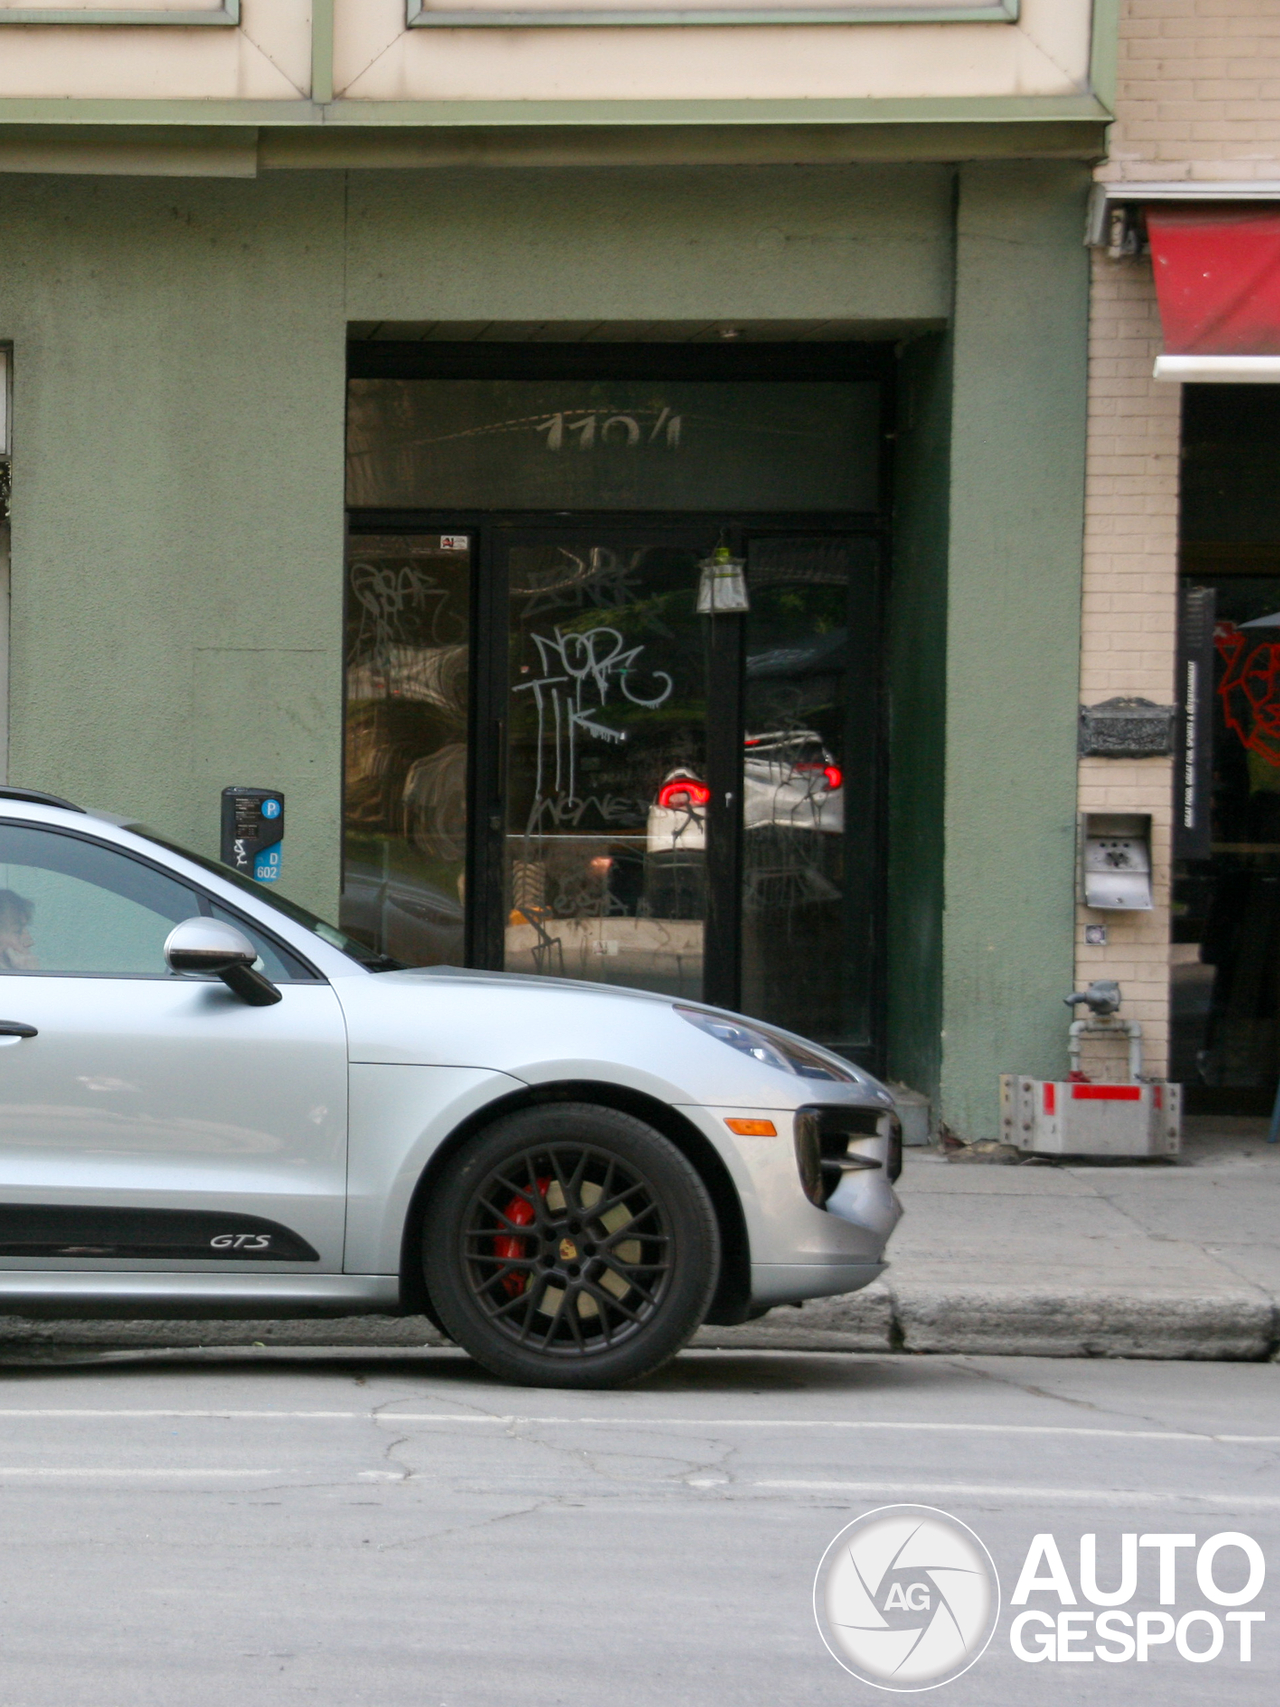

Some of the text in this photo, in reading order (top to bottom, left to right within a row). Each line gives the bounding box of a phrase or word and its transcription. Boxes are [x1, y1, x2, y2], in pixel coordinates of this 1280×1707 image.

[1187, 660, 1196, 714] ENTERTAINMENT
[1186, 721, 1195, 747] SPORTS
[1185, 764, 1194, 786] GREAT
[267, 802, 276, 816] P
[1184, 806, 1193, 828] GREAT
[270, 853, 278, 865] D
[257, 866, 277, 879] 602
[210, 1234, 271, 1248] GTS
